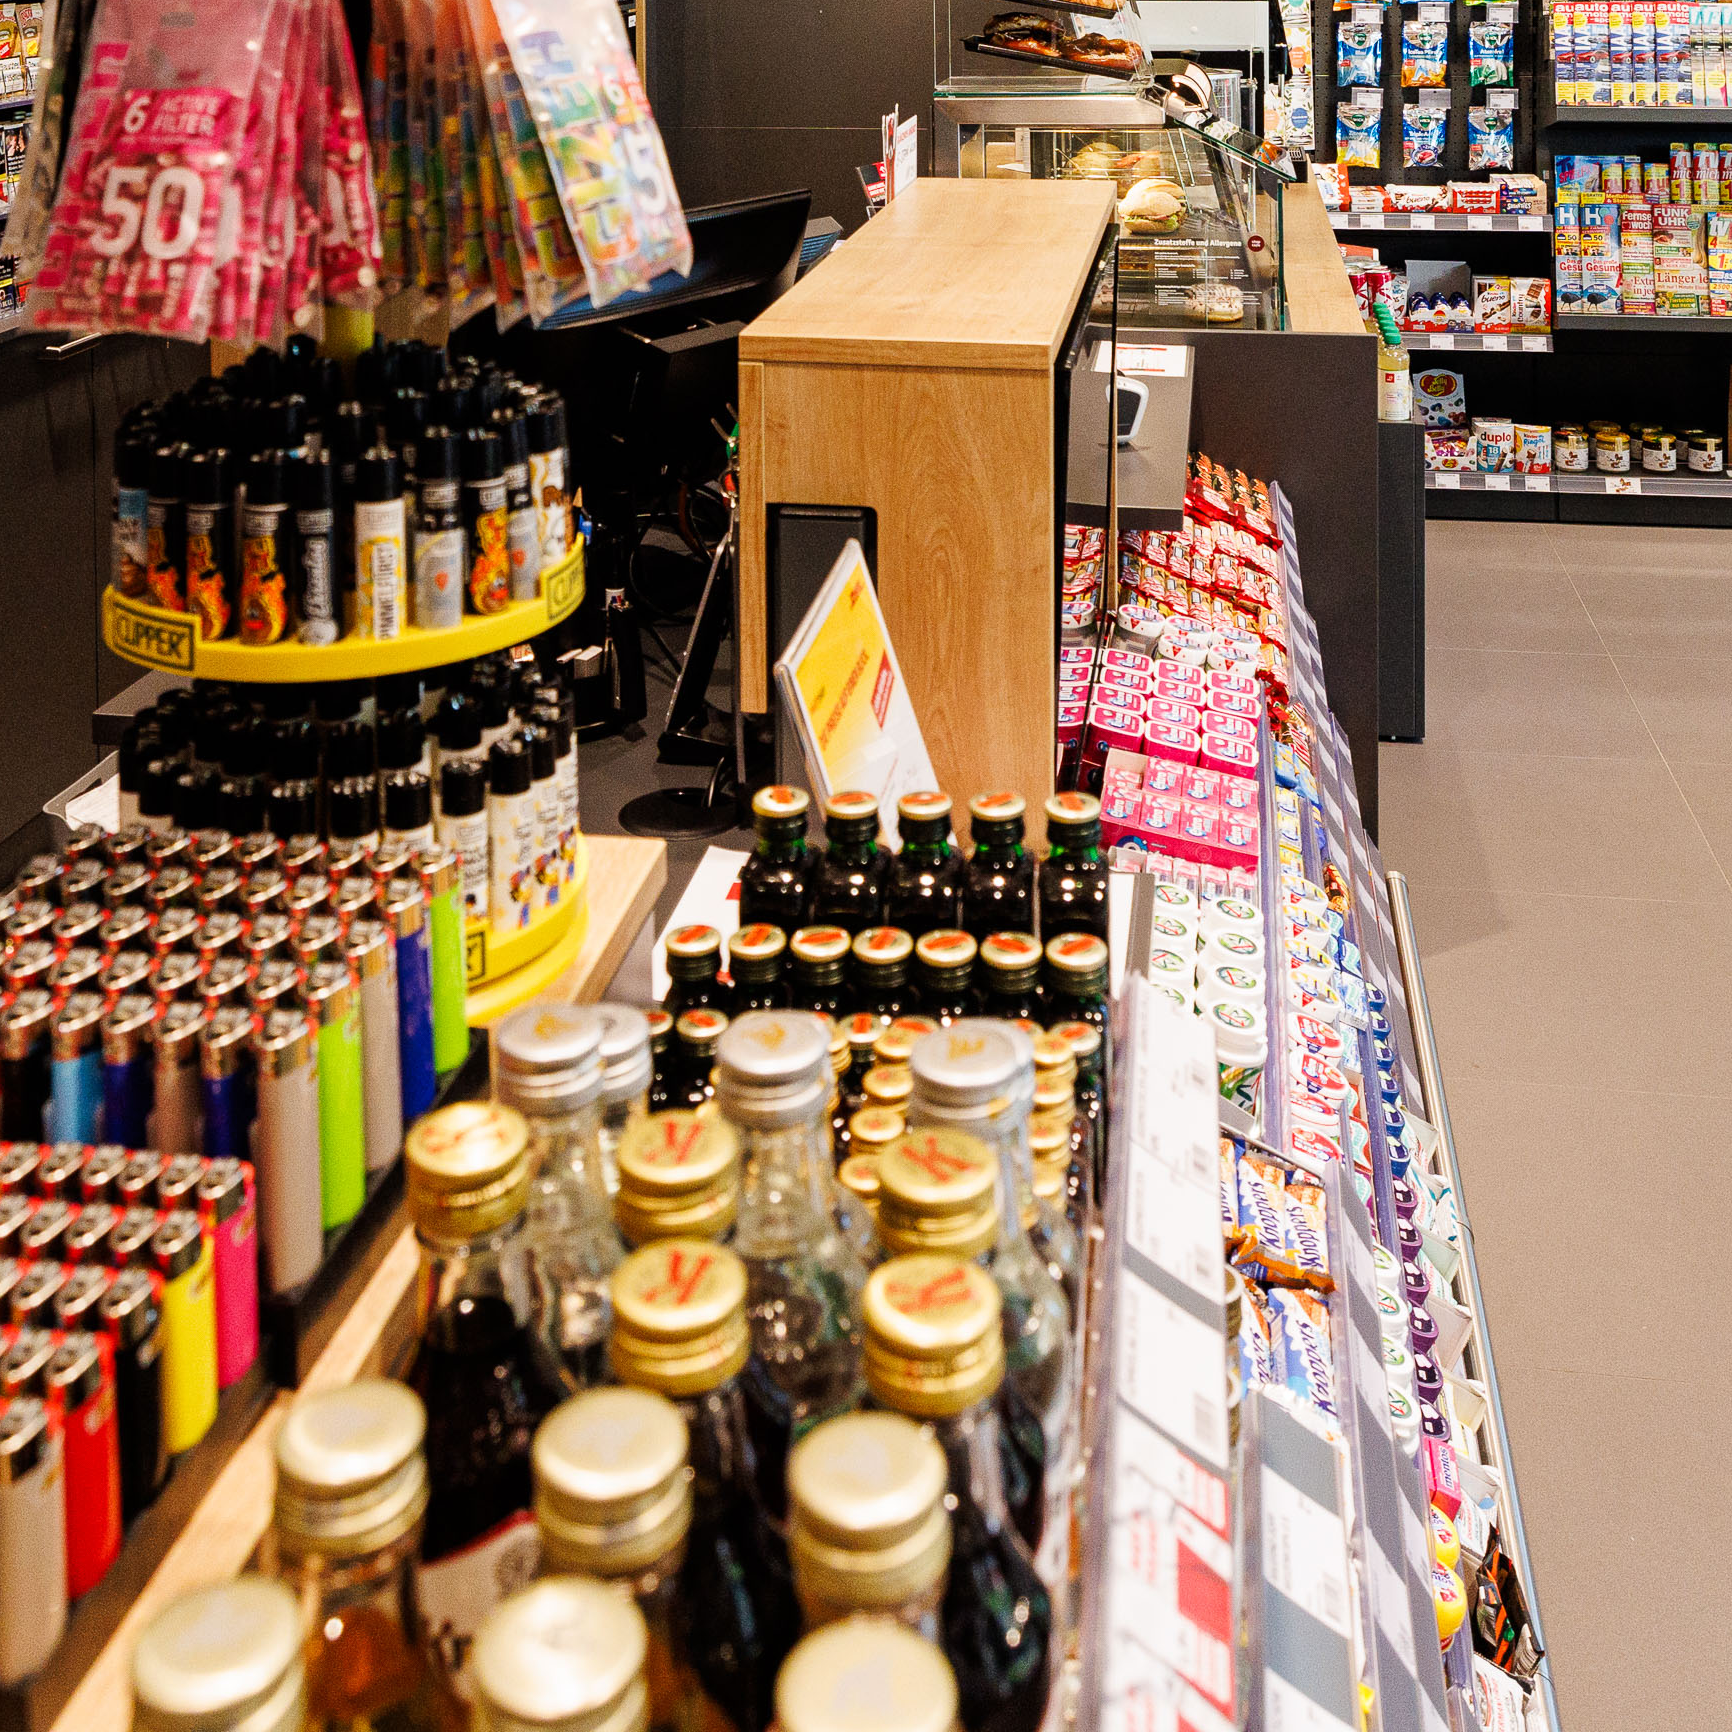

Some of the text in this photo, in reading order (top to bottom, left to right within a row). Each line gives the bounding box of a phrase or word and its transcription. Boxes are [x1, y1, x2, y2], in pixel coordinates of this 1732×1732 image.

[93, 166, 205, 260] 50
[1654, 208, 1688, 217] FUNK
[1658, 217, 1687, 226] UHR
[1153, 238, 1242, 249] Zusatzstoffe und Allergene
[1658, 272, 1689, 285] Länger
[1481, 294, 1506, 303] bueno
[1481, 431, 1512, 445] duplo
[1289, 1310, 1337, 1415] Knoppers
[1439, 1446, 1454, 1489] mentos
